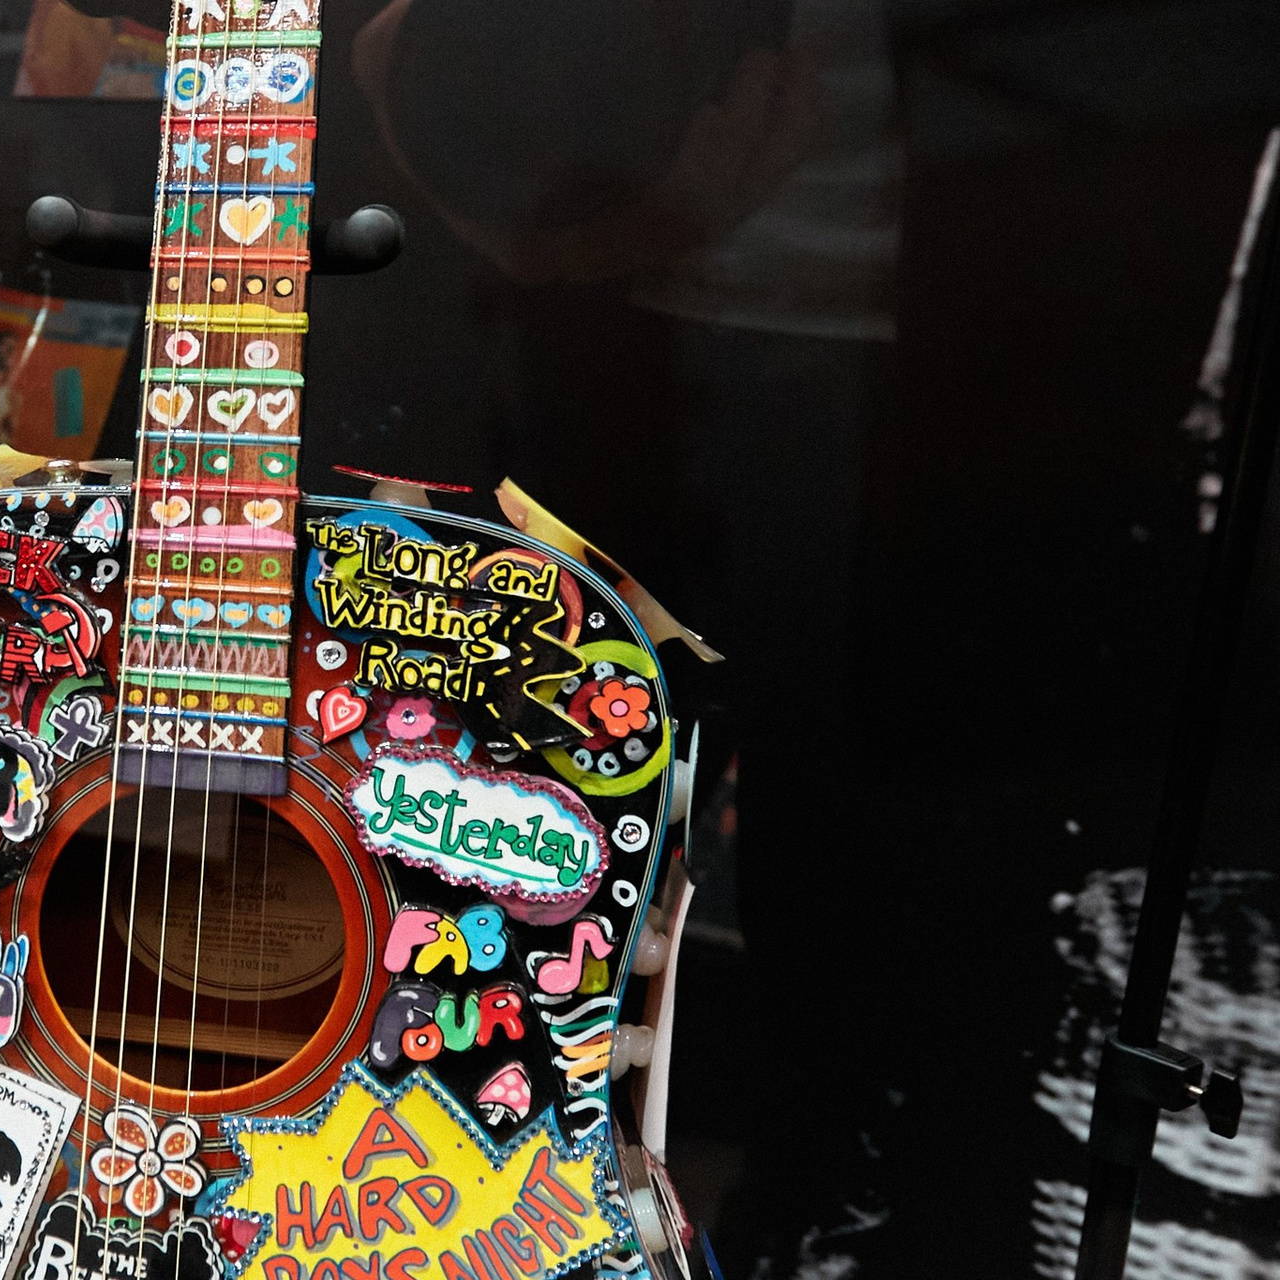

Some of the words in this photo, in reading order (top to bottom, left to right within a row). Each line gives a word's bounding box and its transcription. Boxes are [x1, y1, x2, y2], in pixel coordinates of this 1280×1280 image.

[307, 517, 359, 555] The
[360, 525, 476, 590] Long
[485, 561, 558, 602] and
[316, 578, 503, 662] Winding
[355, 636, 476, 703] Road
[383, 907, 508, 976] FAB
[371, 990, 525, 1069] FOUR
[342, 1107, 429, 1179] A
[275, 1175, 458, 1251] HARD
[98, 1247, 149, 1278] THE
